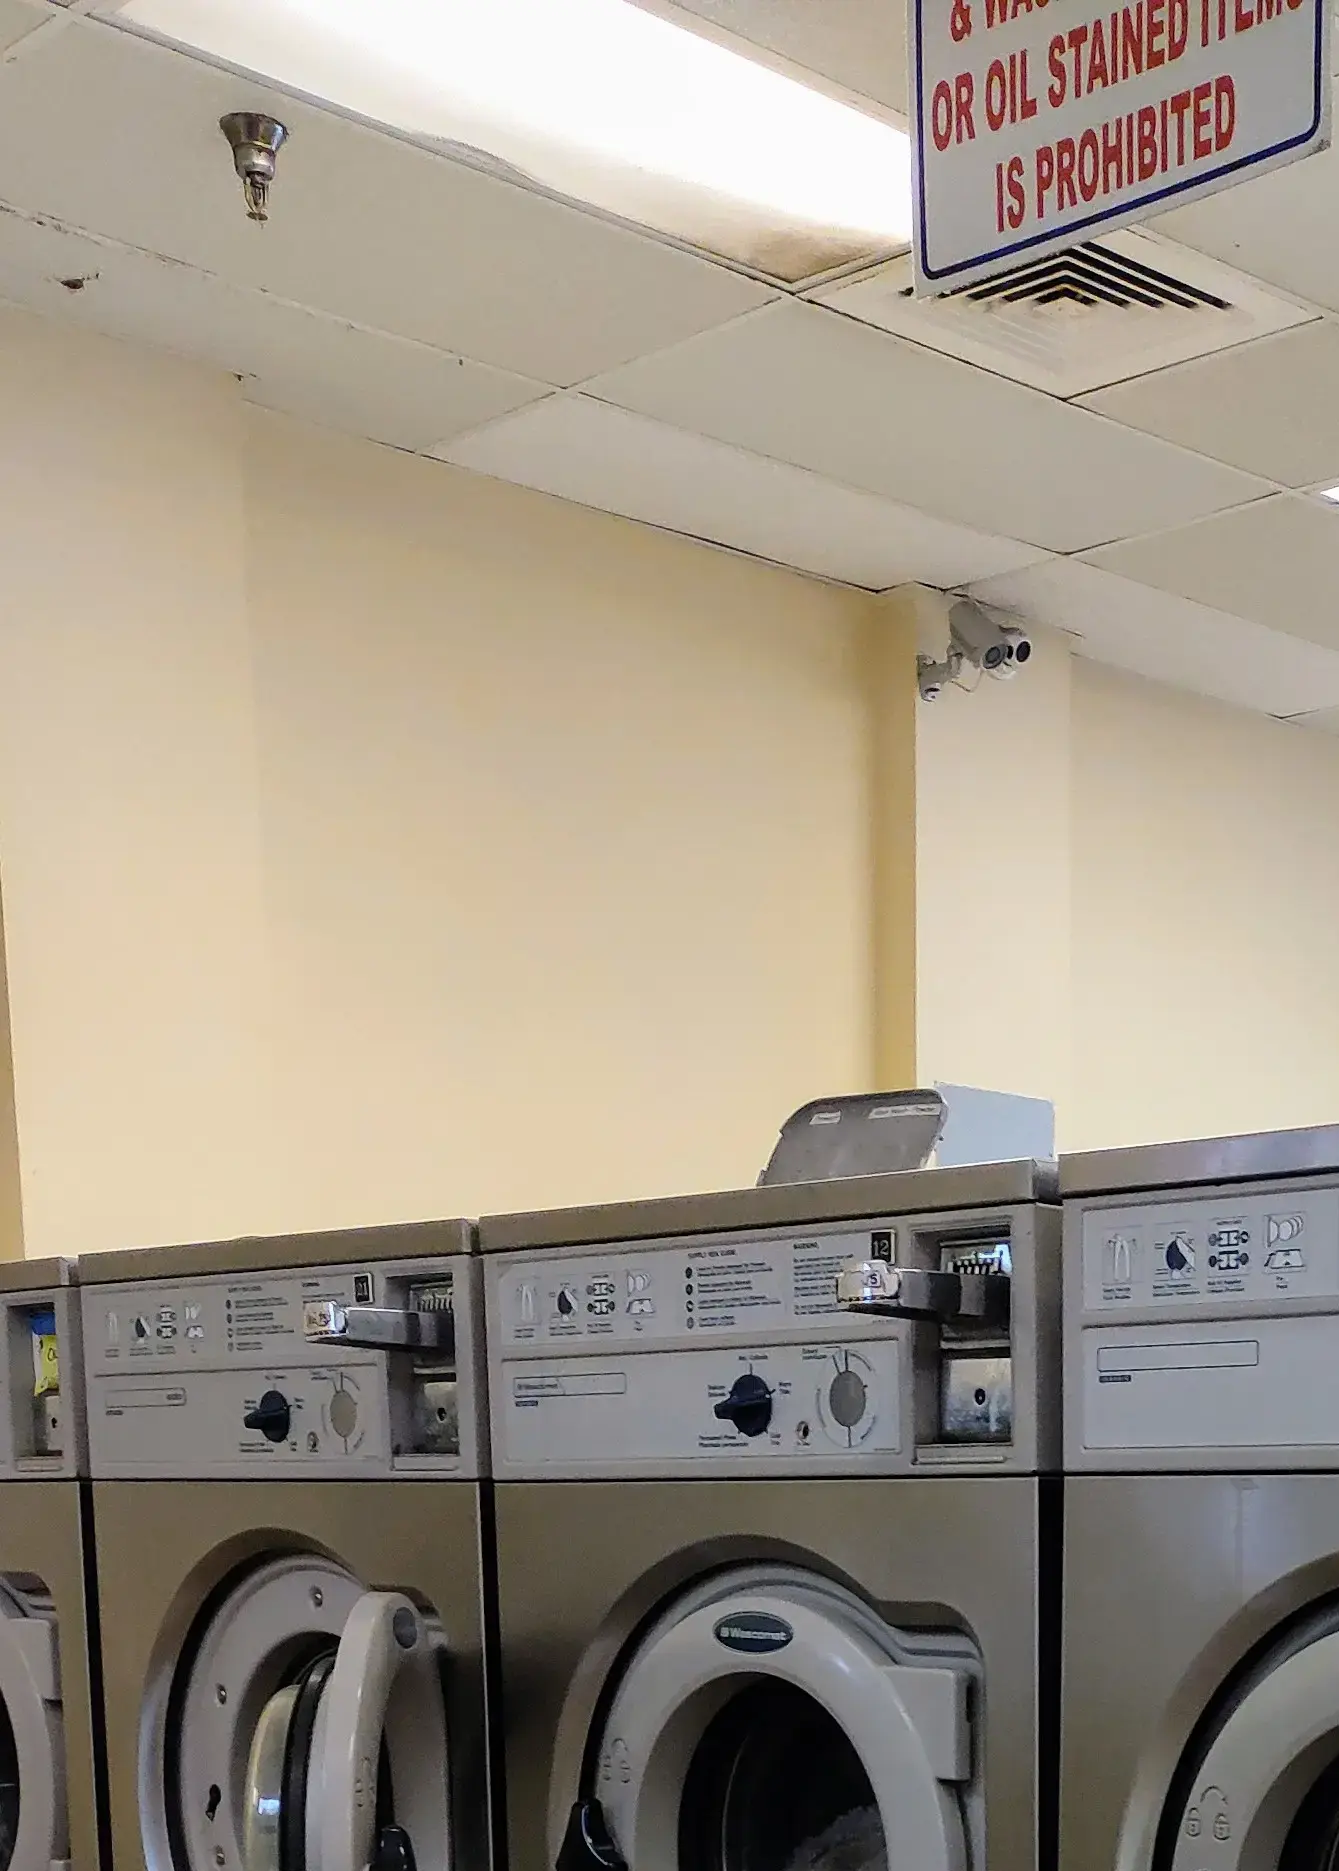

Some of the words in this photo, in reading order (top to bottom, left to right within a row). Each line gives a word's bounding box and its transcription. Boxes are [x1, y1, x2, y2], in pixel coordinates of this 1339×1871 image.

[932, 72, 976, 152] OR
[985, 49, 1039, 131] OIL
[1048, 0, 1189, 109] STAINED
[996, 156, 1025, 233] IS
[1036, 75, 1237, 220] PROHIBITED
[872, 1239, 890, 1257] 12
